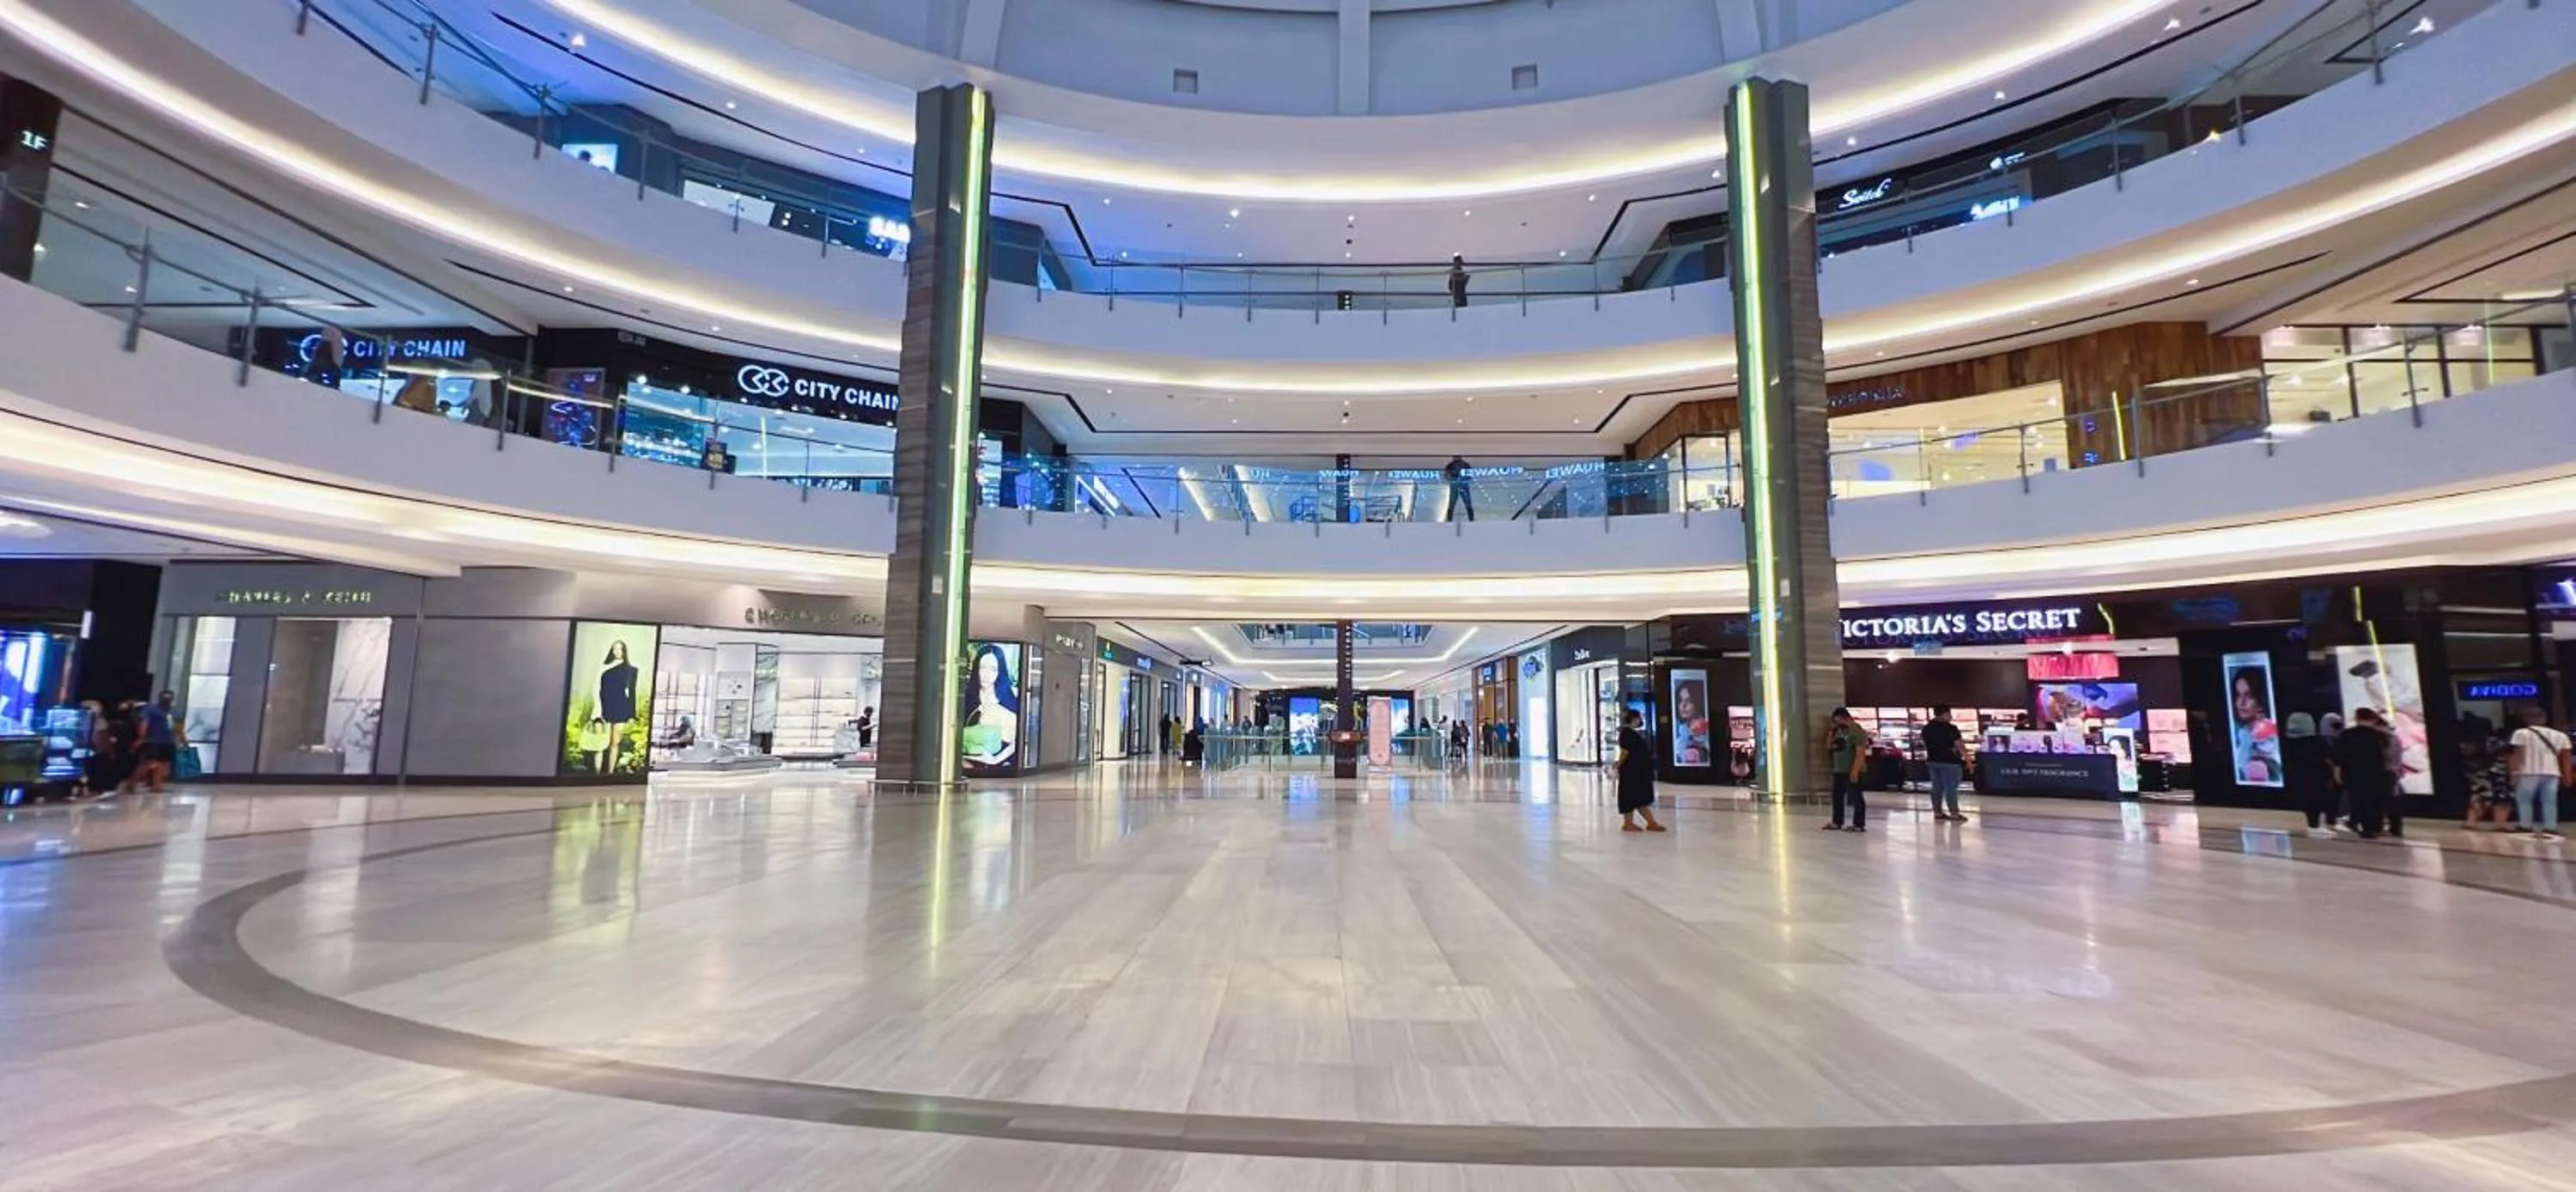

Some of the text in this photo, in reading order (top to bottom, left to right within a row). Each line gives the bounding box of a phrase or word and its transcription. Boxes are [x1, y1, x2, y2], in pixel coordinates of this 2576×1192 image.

[353, 339, 466, 359] CITY CHAIN
[794, 379, 841, 401] CITY
[1976, 608, 2081, 632] SECRET
